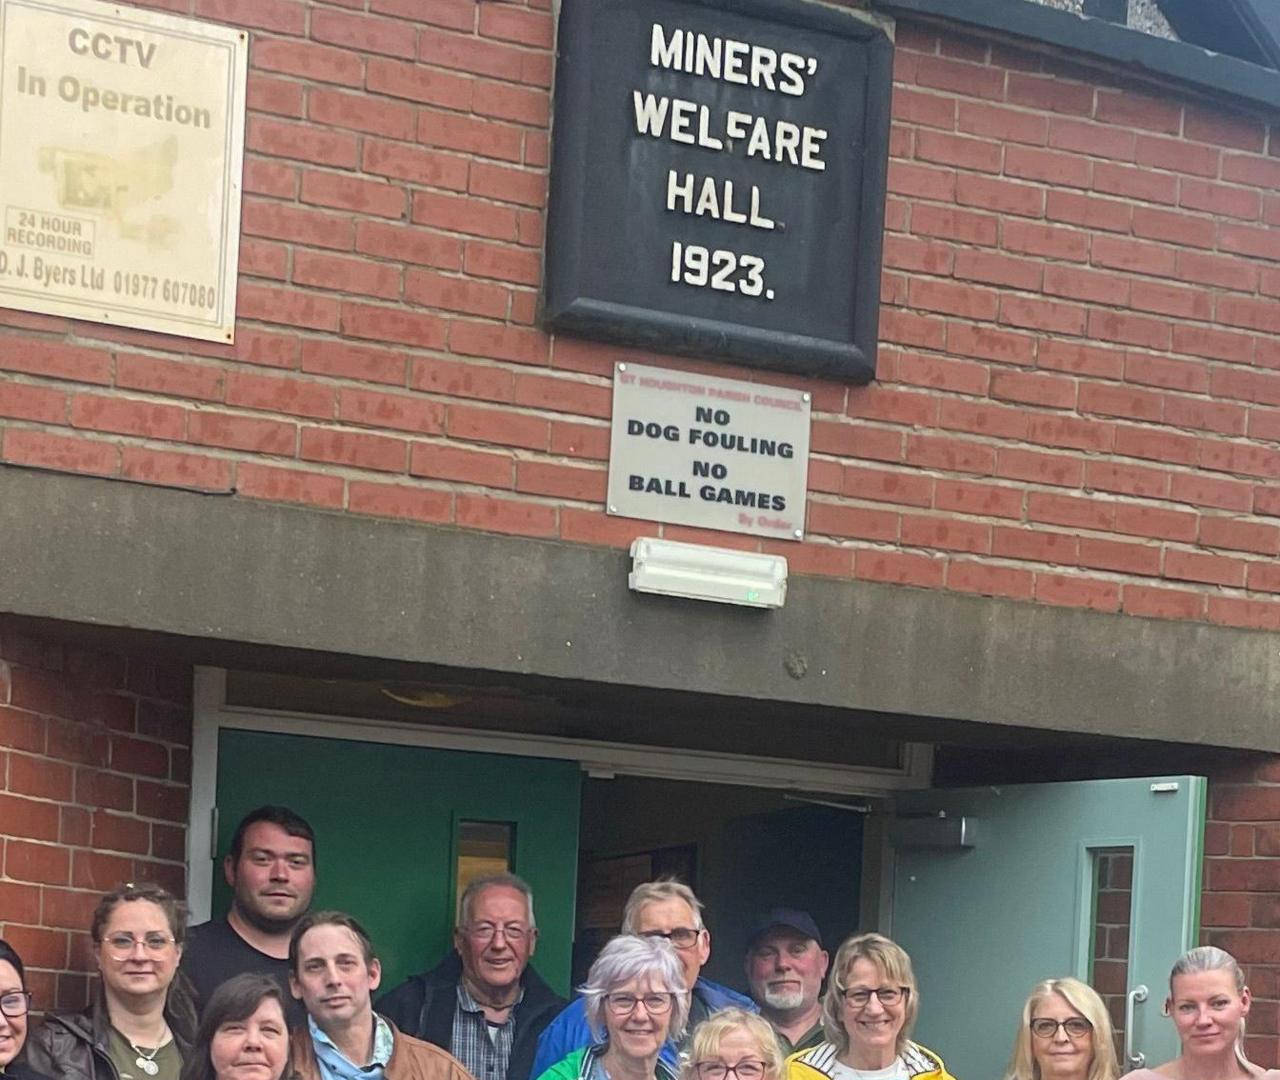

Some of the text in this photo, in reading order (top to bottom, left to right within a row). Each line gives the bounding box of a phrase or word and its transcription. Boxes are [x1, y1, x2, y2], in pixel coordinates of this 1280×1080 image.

[68, 27, 157, 70] CCTV
[650, 22, 818, 97] MINERS'
[17, 65, 212, 130] In Operation
[632, 89, 828, 171] WELFARE
[666, 169, 775, 230] HALL
[7, 227, 93, 256] RECORDING
[18, 211, 83, 237] 24 HOUR
[16, 255, 29, 280] J.
[32, 259, 77, 288] Byers
[80, 266, 105, 292] Ltd
[113, 270, 158, 300] 01977
[670, 240, 776, 301] 1923.
[695, 406, 731, 427] NO
[627, 418, 794, 460] DOG FOULING
[691, 460, 728, 480] NO
[628, 474, 787, 512] BALL GAMES
